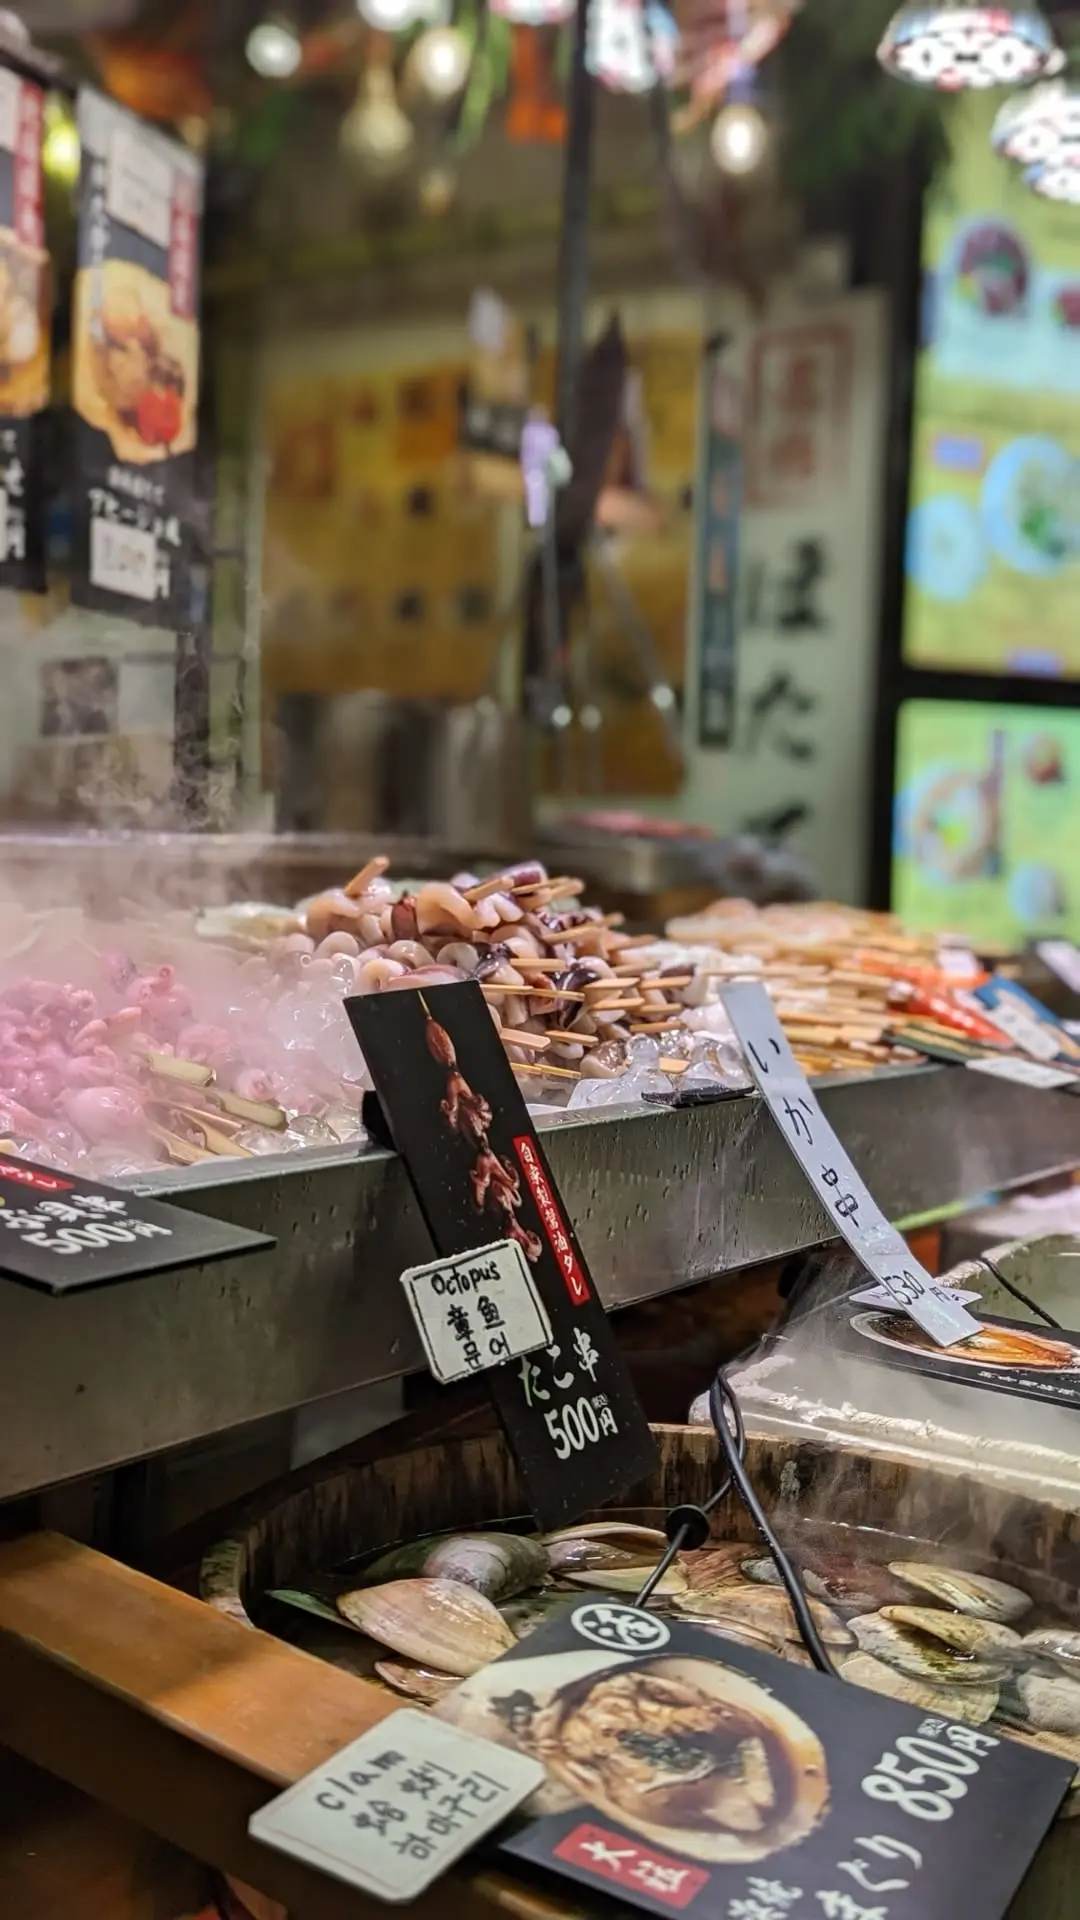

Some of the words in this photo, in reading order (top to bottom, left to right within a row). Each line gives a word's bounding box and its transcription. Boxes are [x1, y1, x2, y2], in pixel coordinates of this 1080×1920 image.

[748, 1037, 860, 1229] いか串
[543, 1396, 618, 1460] 500円
[861, 1725, 1000, 1821] 850円
